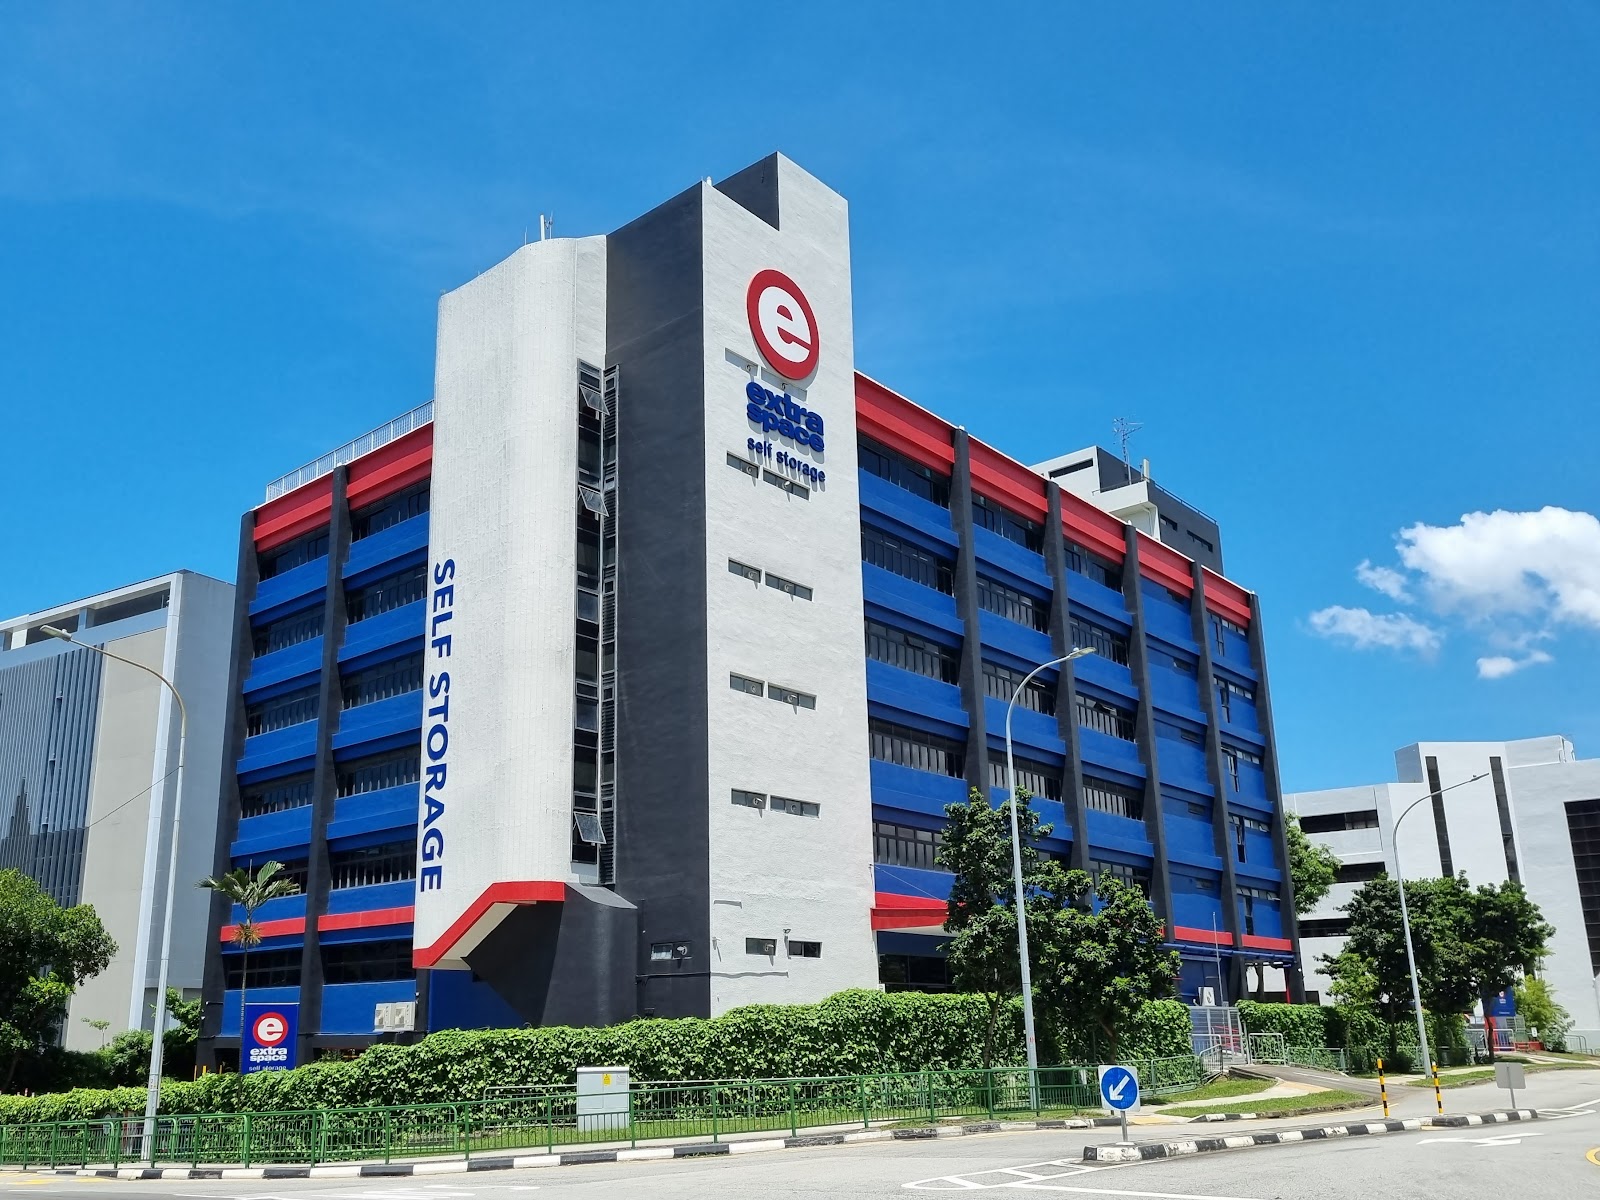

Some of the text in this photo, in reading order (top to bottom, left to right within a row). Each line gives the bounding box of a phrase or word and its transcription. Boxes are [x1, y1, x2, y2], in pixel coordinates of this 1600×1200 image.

[757, 285, 812, 364] e
[745, 380, 824, 436] extra
[746, 401, 825, 453] space
[747, 437, 826, 483] self storage
[420, 558, 455, 893] SELF STORAGE
[250, 1046, 288, 1055] extra
[257, 1017, 284, 1042] e
[249, 1055, 288, 1063] space
